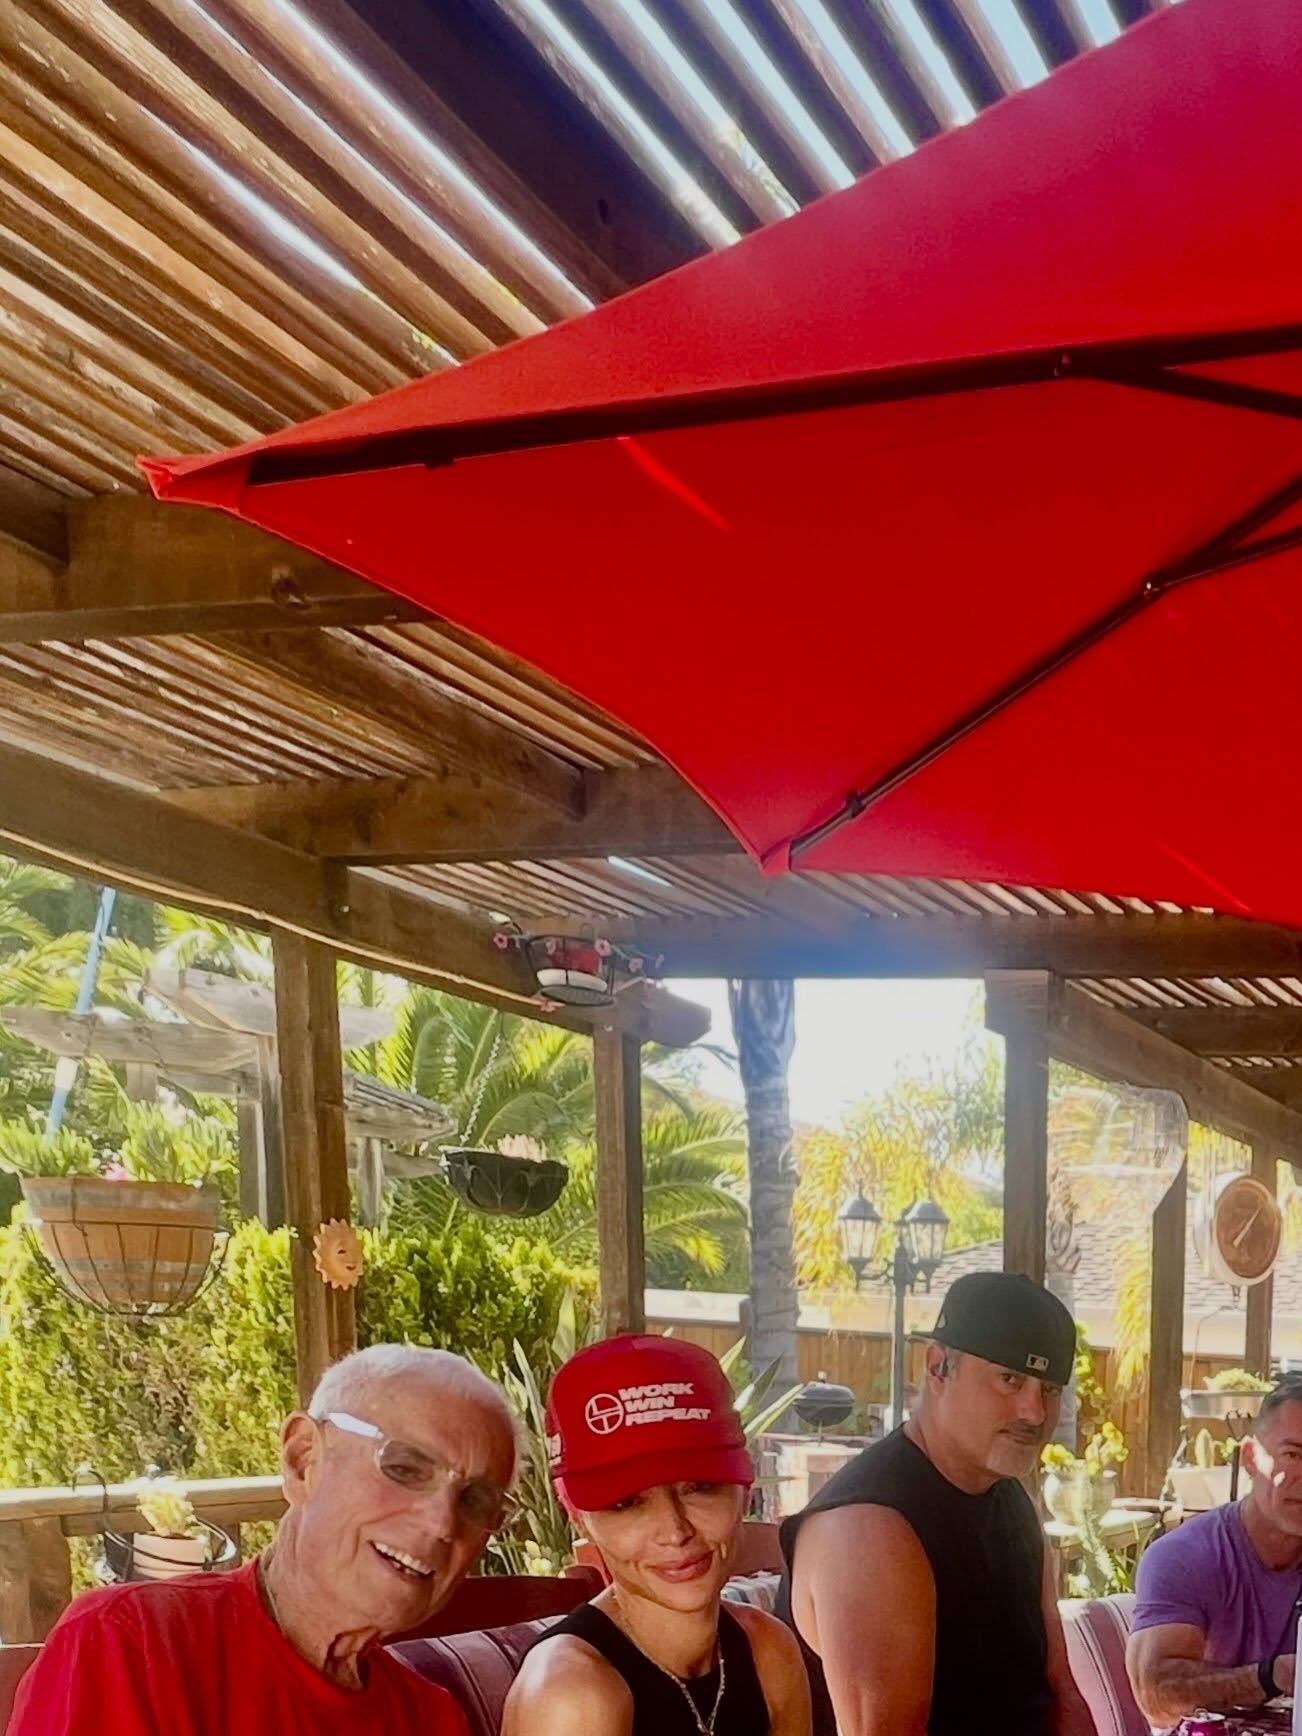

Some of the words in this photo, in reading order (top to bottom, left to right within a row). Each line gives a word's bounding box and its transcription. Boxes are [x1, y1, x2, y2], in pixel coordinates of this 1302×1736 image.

[618, 1383, 694, 1401] WORK
[624, 1396, 675, 1413] WIN
[625, 1408, 711, 1427] REPEAT
